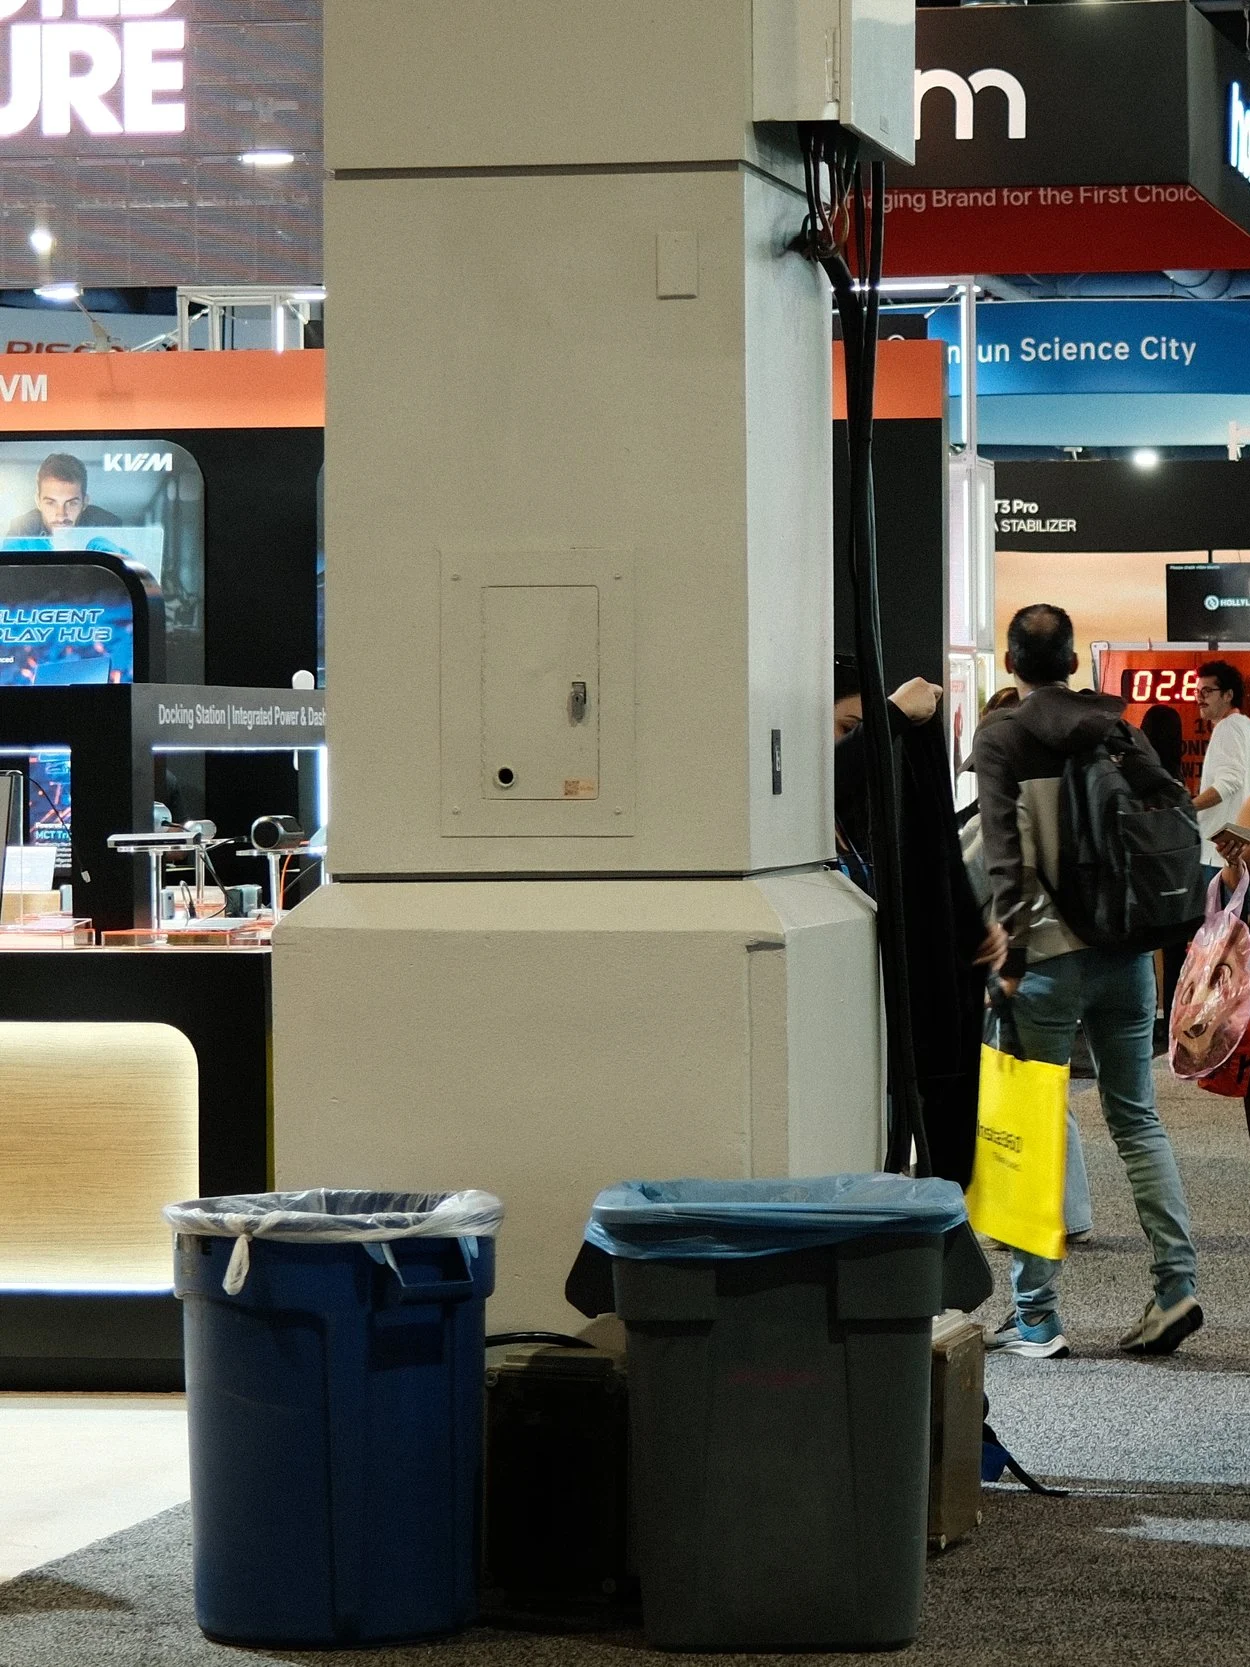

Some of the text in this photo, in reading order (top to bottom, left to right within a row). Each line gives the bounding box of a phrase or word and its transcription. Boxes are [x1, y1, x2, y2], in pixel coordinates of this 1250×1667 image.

[932, 188, 996, 208] Brand
[1003, 188, 1033, 205] for
[1038, 187, 1073, 205] the
[1080, 186, 1128, 204] First
[1020, 336, 1130, 362] Science
[1140, 336, 1197, 366] City
[1013, 500, 1039, 514] Pro
[1001, 519, 1077, 532] STABILIZER
[0, 608, 104, 624] LLIGENT
[0, 627, 113, 643] LAY HUB
[158, 703, 194, 730] Docking
[195, 704, 226, 725] Station
[232, 705, 273, 731] Integrated
[274, 706, 300, 726] Power
